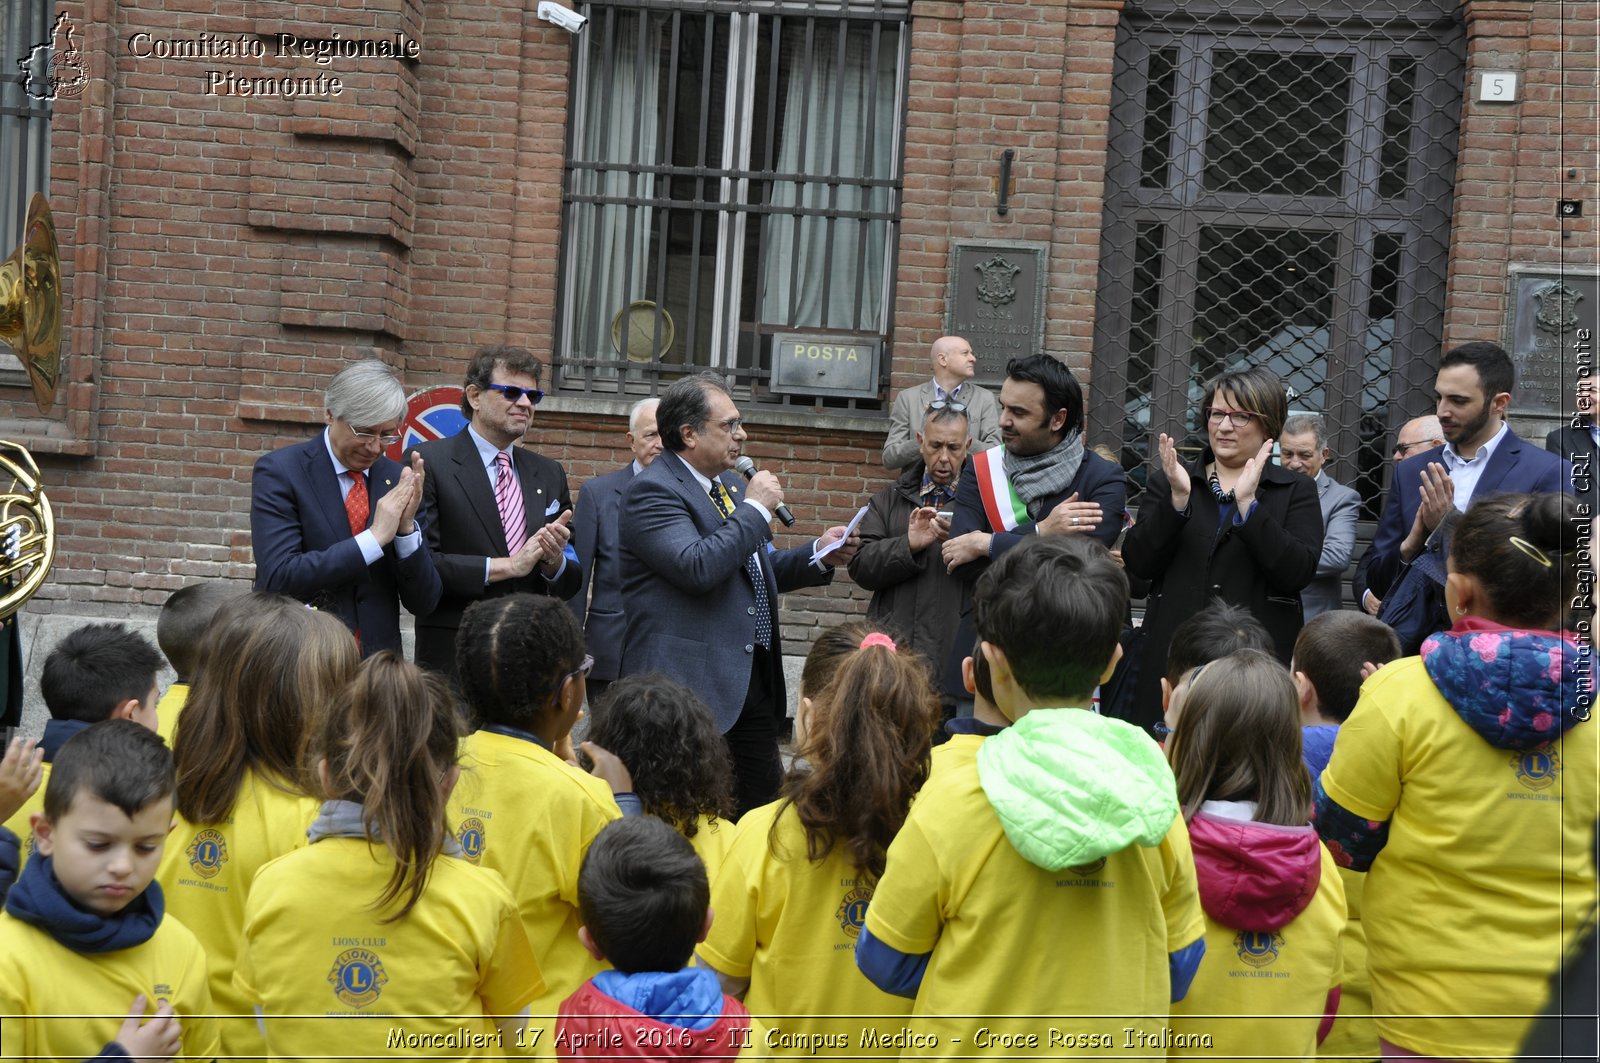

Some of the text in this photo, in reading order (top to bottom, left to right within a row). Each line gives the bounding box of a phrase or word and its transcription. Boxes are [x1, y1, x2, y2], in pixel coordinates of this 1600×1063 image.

[1493, 79, 1504, 96] 5
[794, 344, 858, 362] POSTA
[1530, 755, 1545, 774] L
[461, 806, 479, 817] LIONS
[200, 831, 225, 844] LIONS
[468, 833, 479, 852] L
[203, 844, 215, 863] L
[856, 904, 866, 922] L
[332, 937, 387, 946] LIONS CLUB
[1252, 931, 1266, 949] L
[341, 950, 376, 963] LIONS
[351, 966, 367, 988] L
